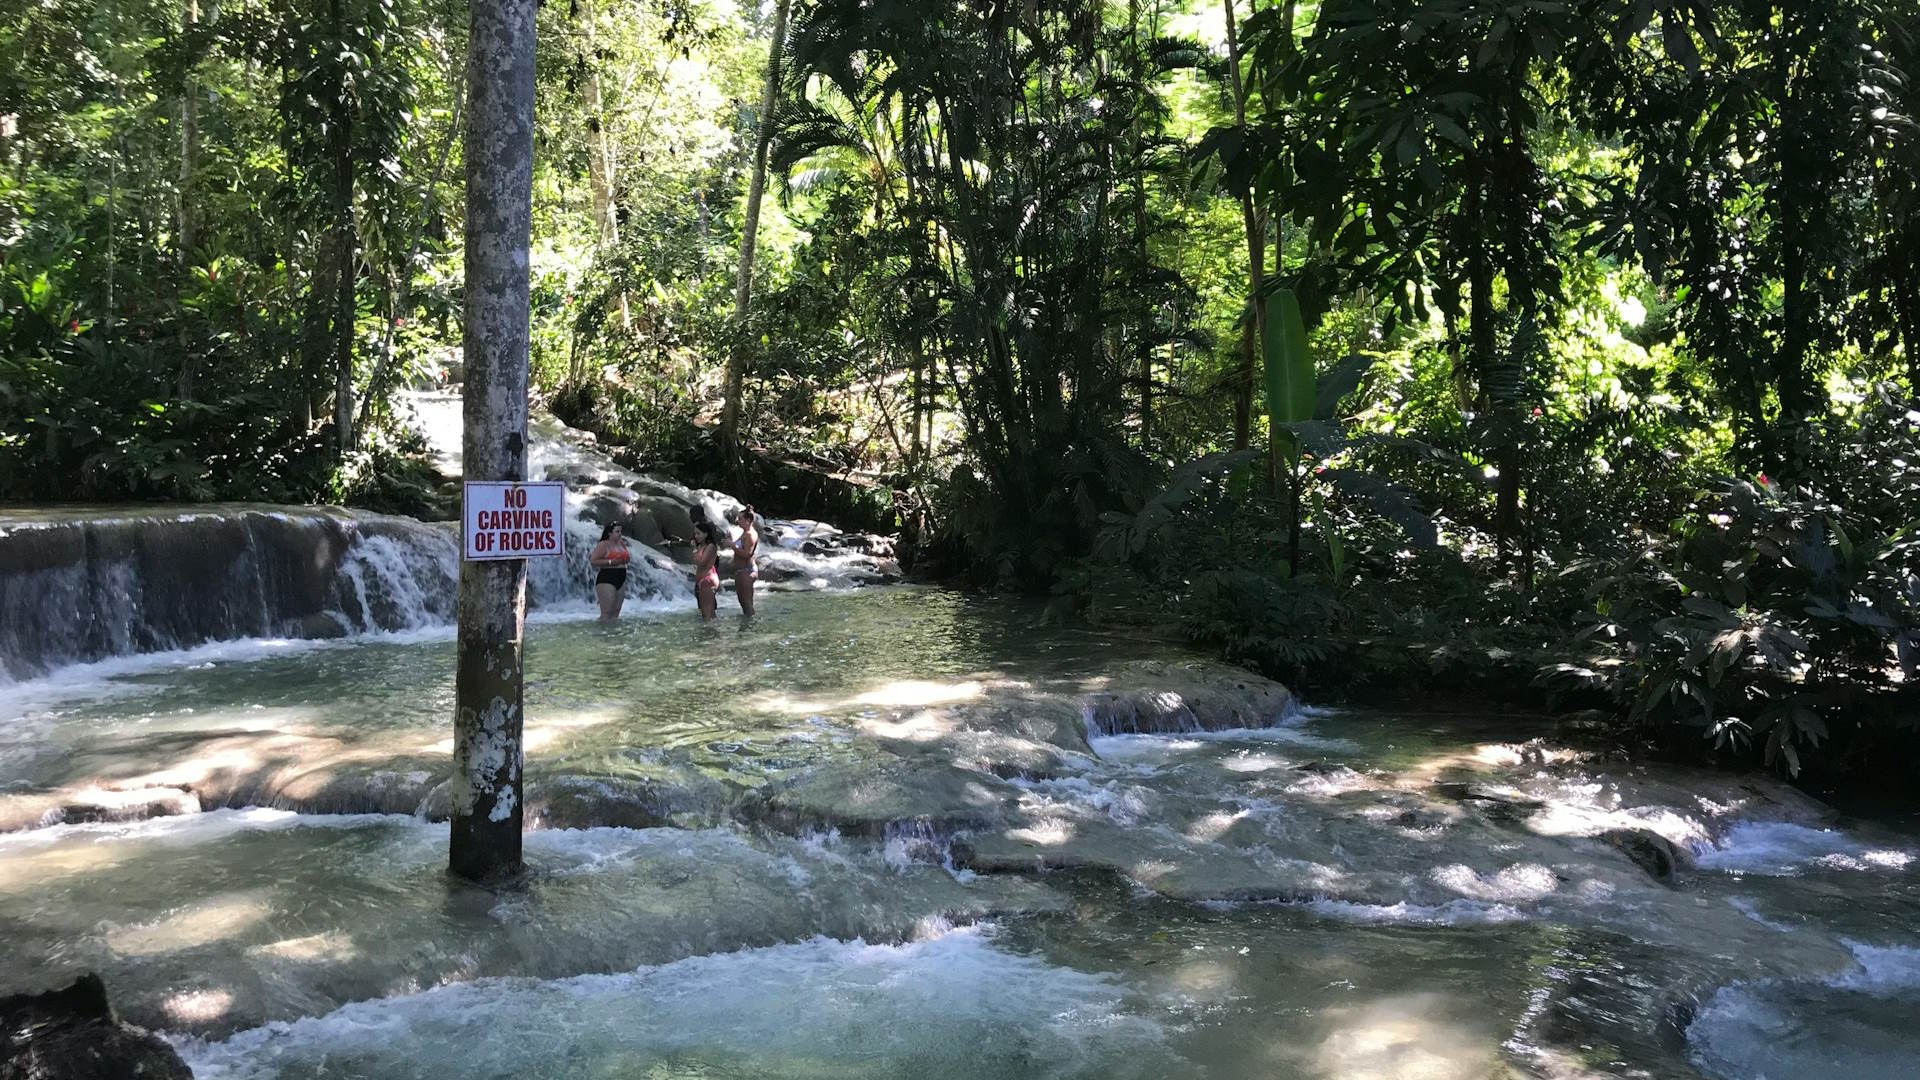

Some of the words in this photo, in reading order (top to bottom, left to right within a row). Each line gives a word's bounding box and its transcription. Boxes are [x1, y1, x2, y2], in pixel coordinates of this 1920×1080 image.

[504, 489, 527, 508] NO
[478, 510, 552, 530] CARVING
[475, 532, 495, 552] OF
[500, 531, 556, 551] ROCKS
